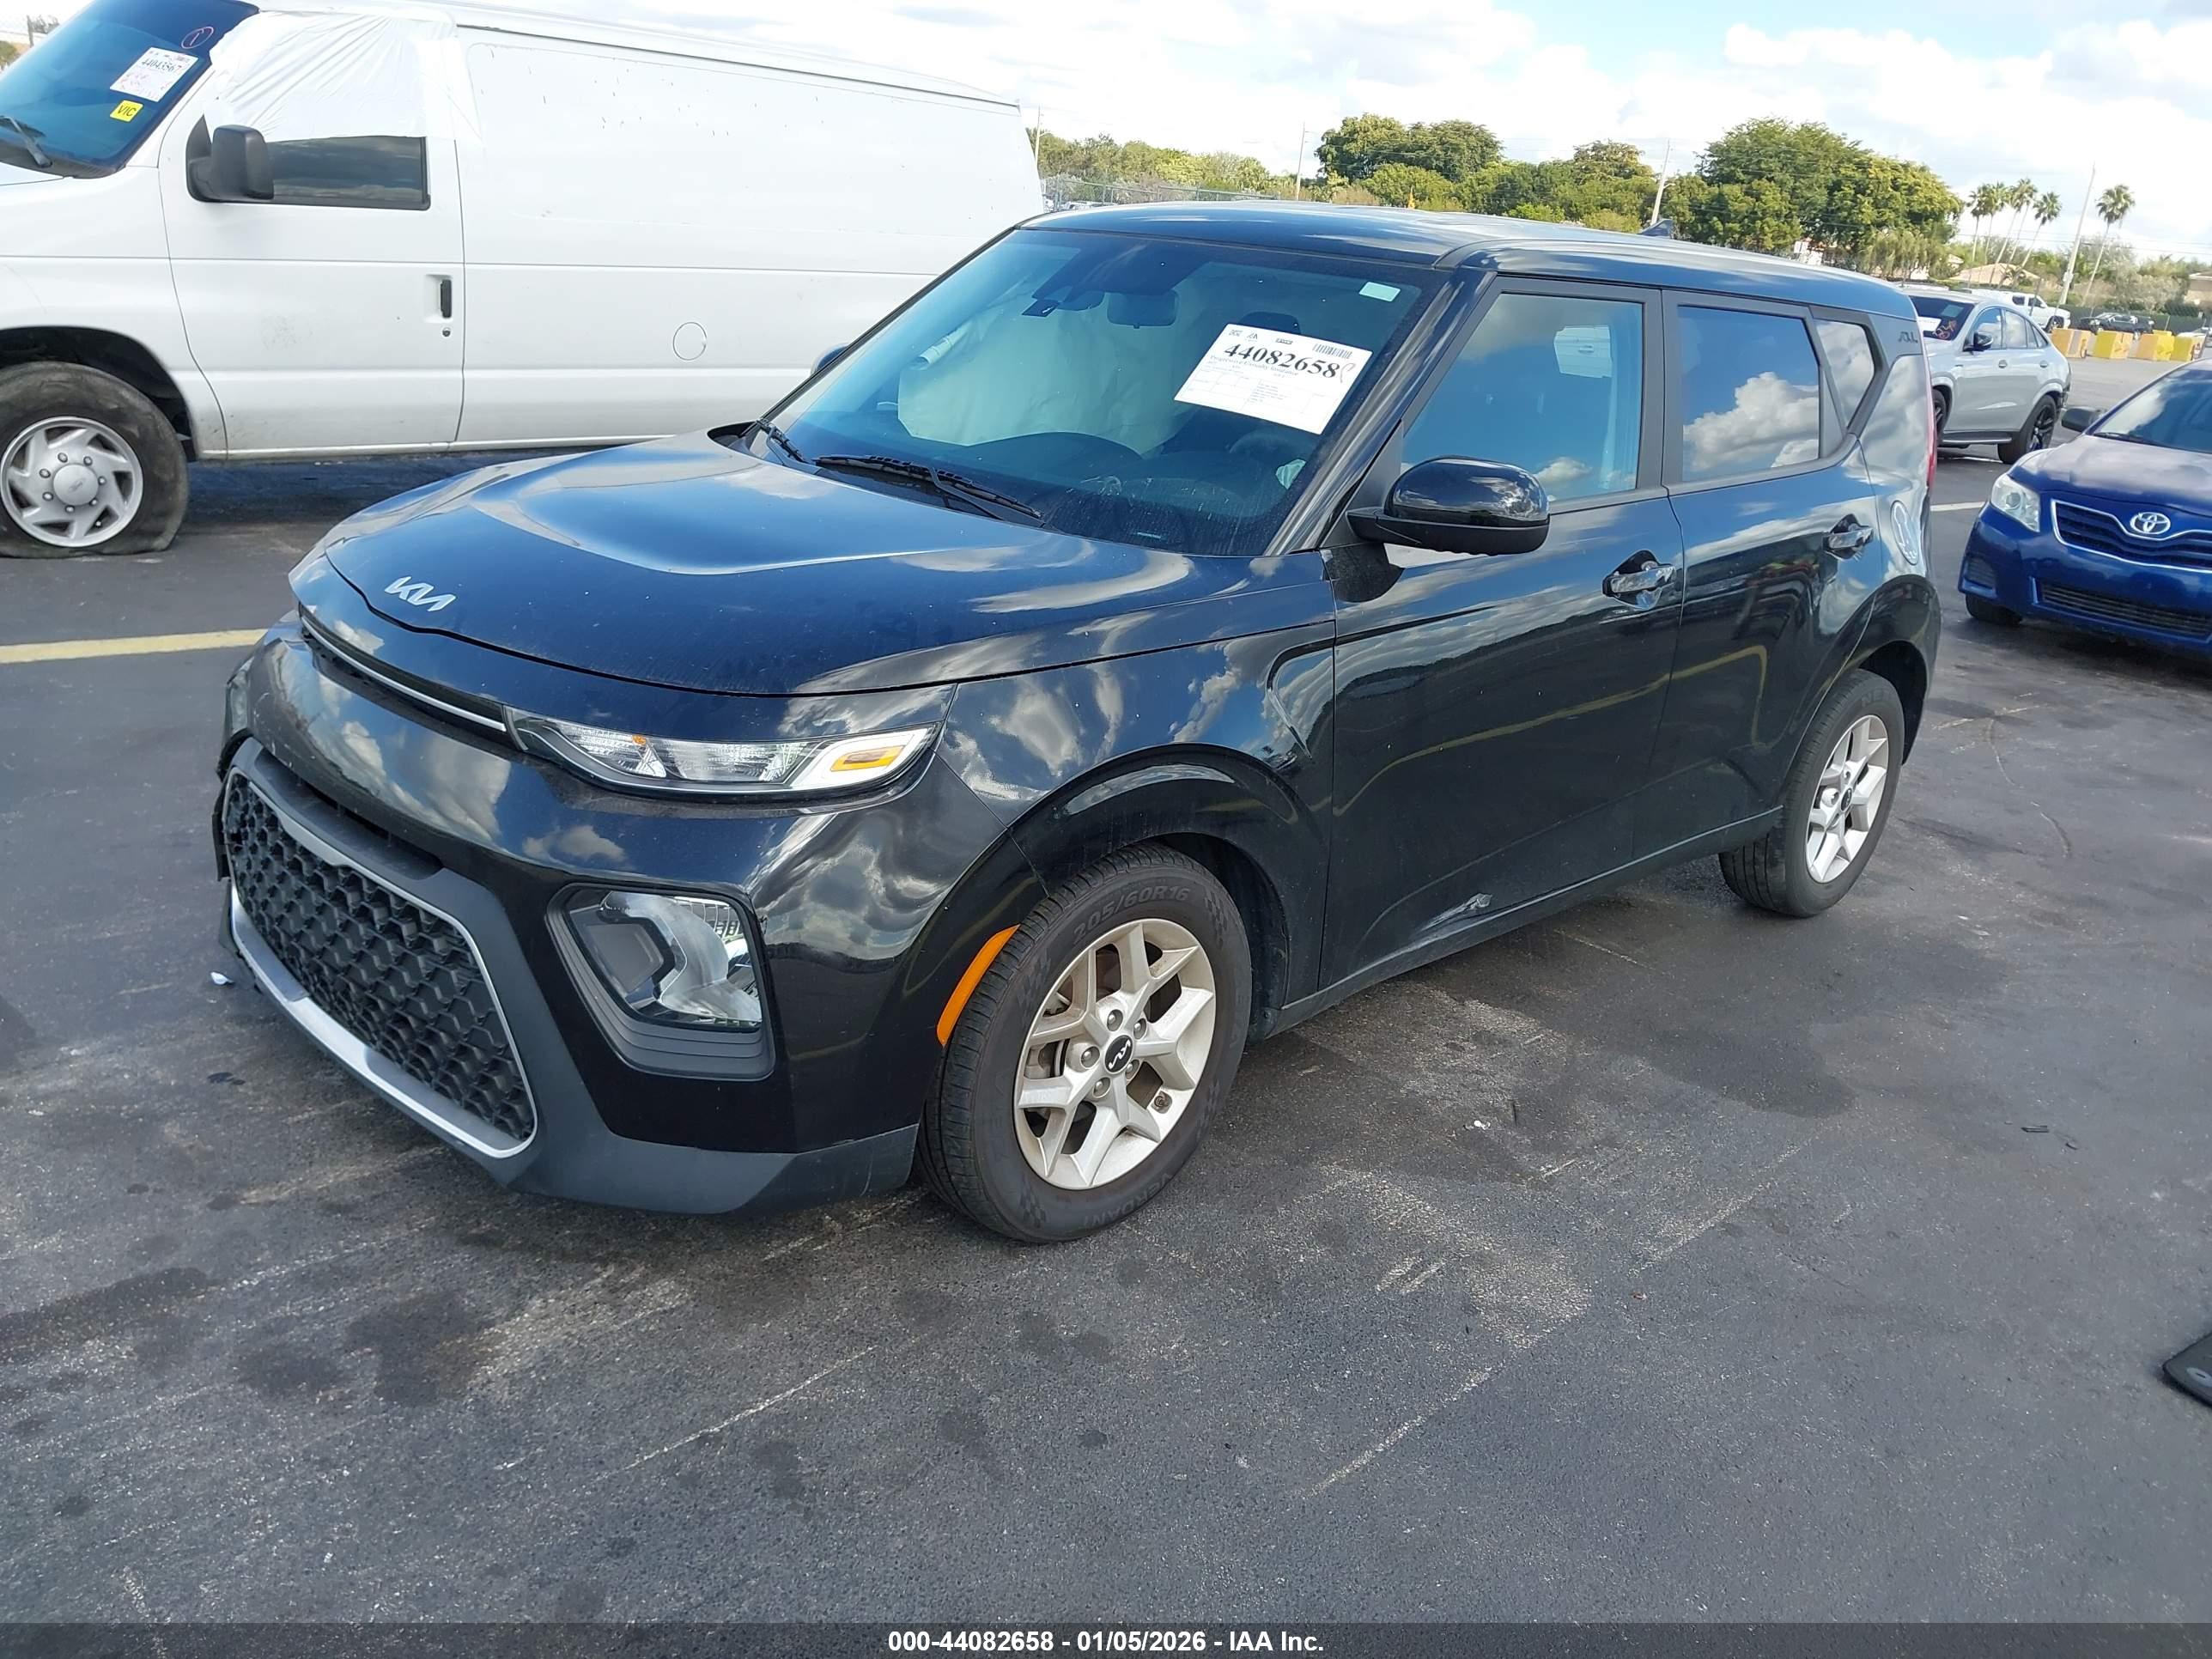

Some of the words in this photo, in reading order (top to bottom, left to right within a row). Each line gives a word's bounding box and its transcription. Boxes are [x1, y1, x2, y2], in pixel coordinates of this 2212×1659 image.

[118, 104, 137, 118] VIC
[1224, 343, 1340, 379] 44082658
[1073, 884, 1192, 945] 205/60R16
